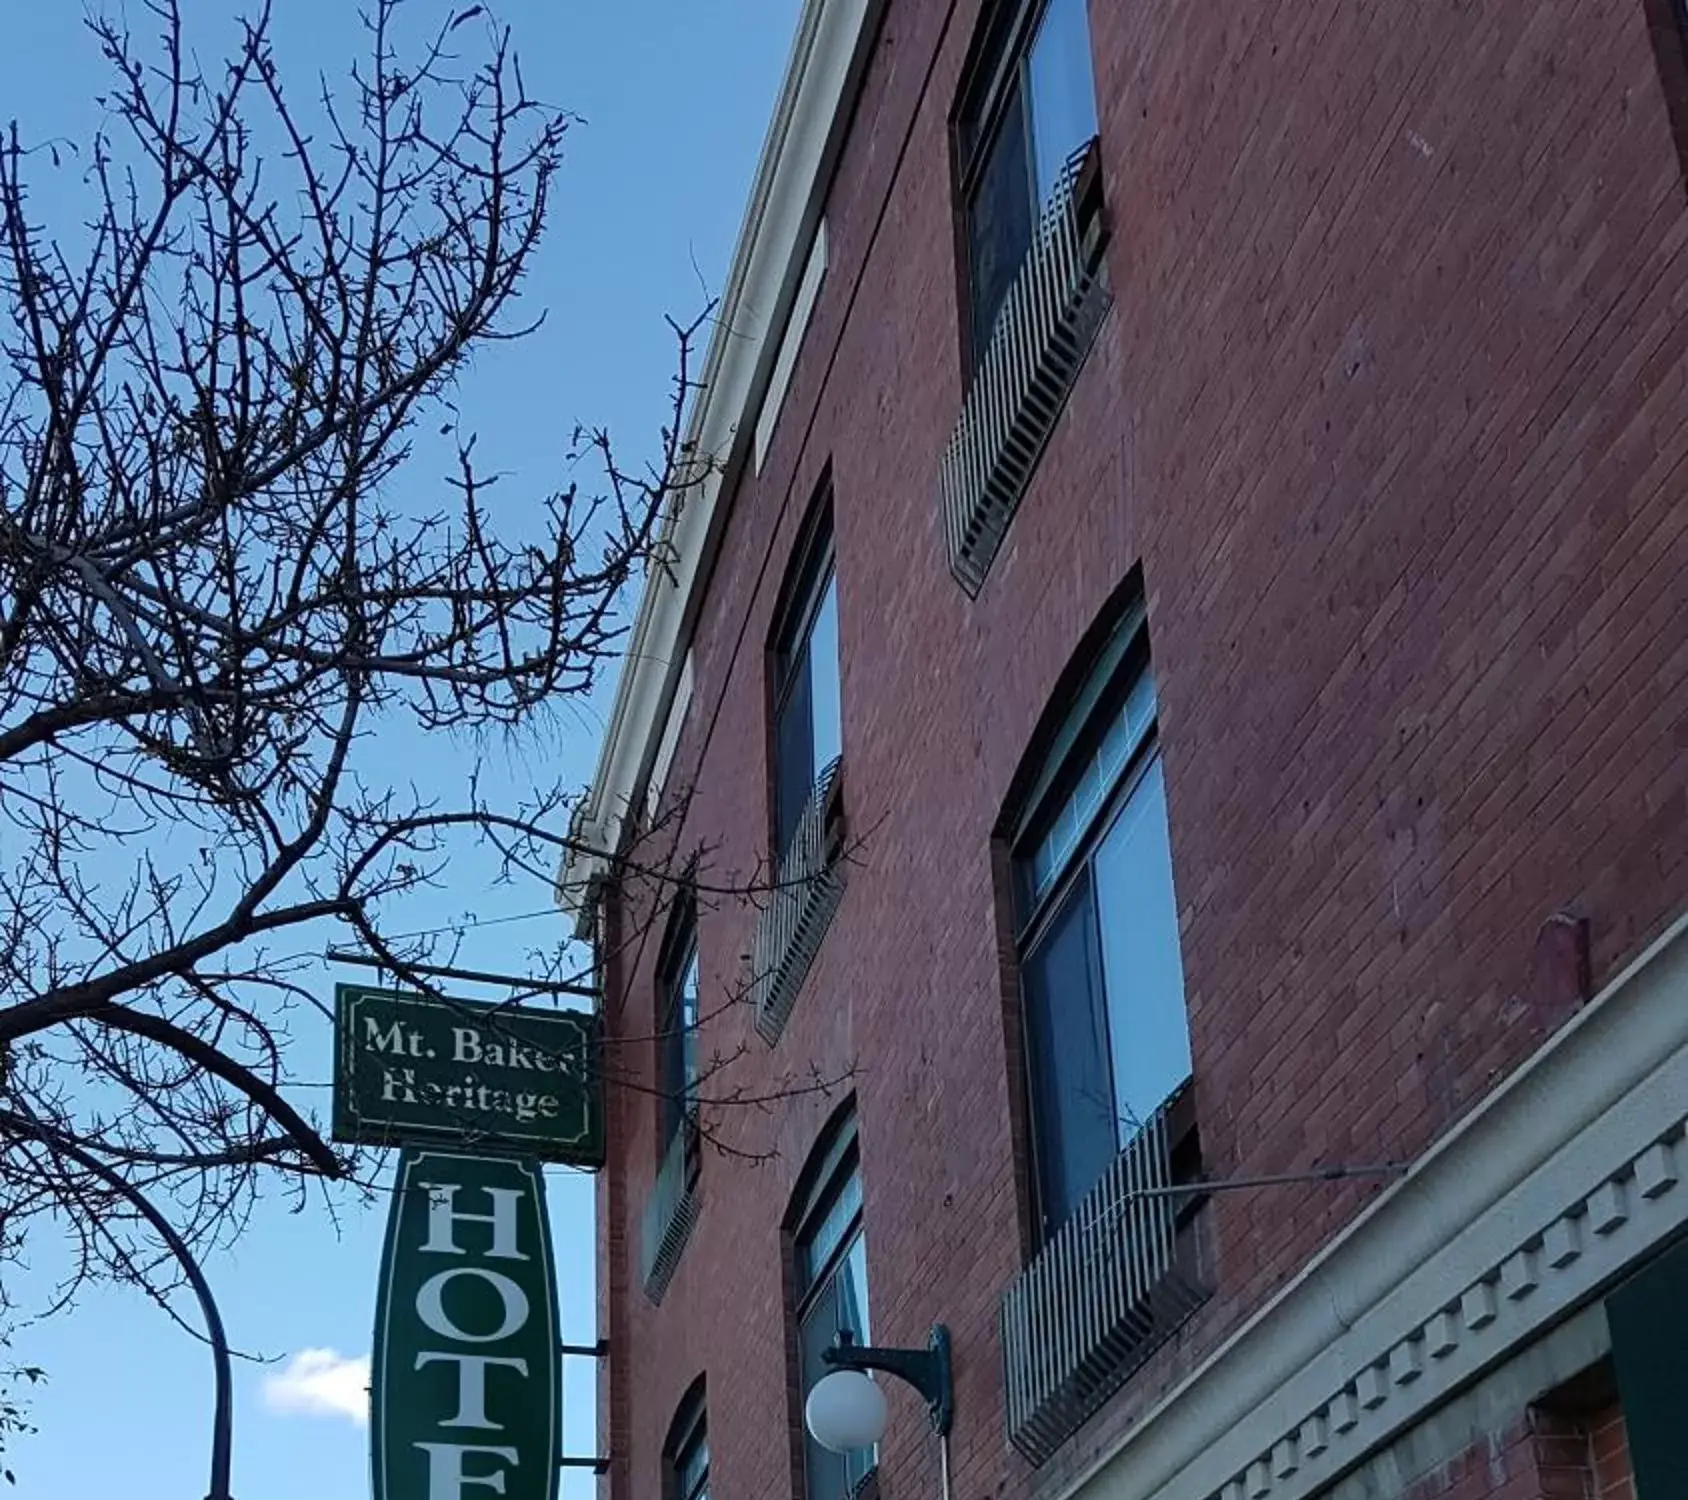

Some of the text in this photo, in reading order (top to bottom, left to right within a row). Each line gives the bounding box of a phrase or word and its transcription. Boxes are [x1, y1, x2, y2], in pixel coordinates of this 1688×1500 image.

[363, 1016, 576, 1076] Mt. Baker
[380, 1066, 561, 1124] Heritage
